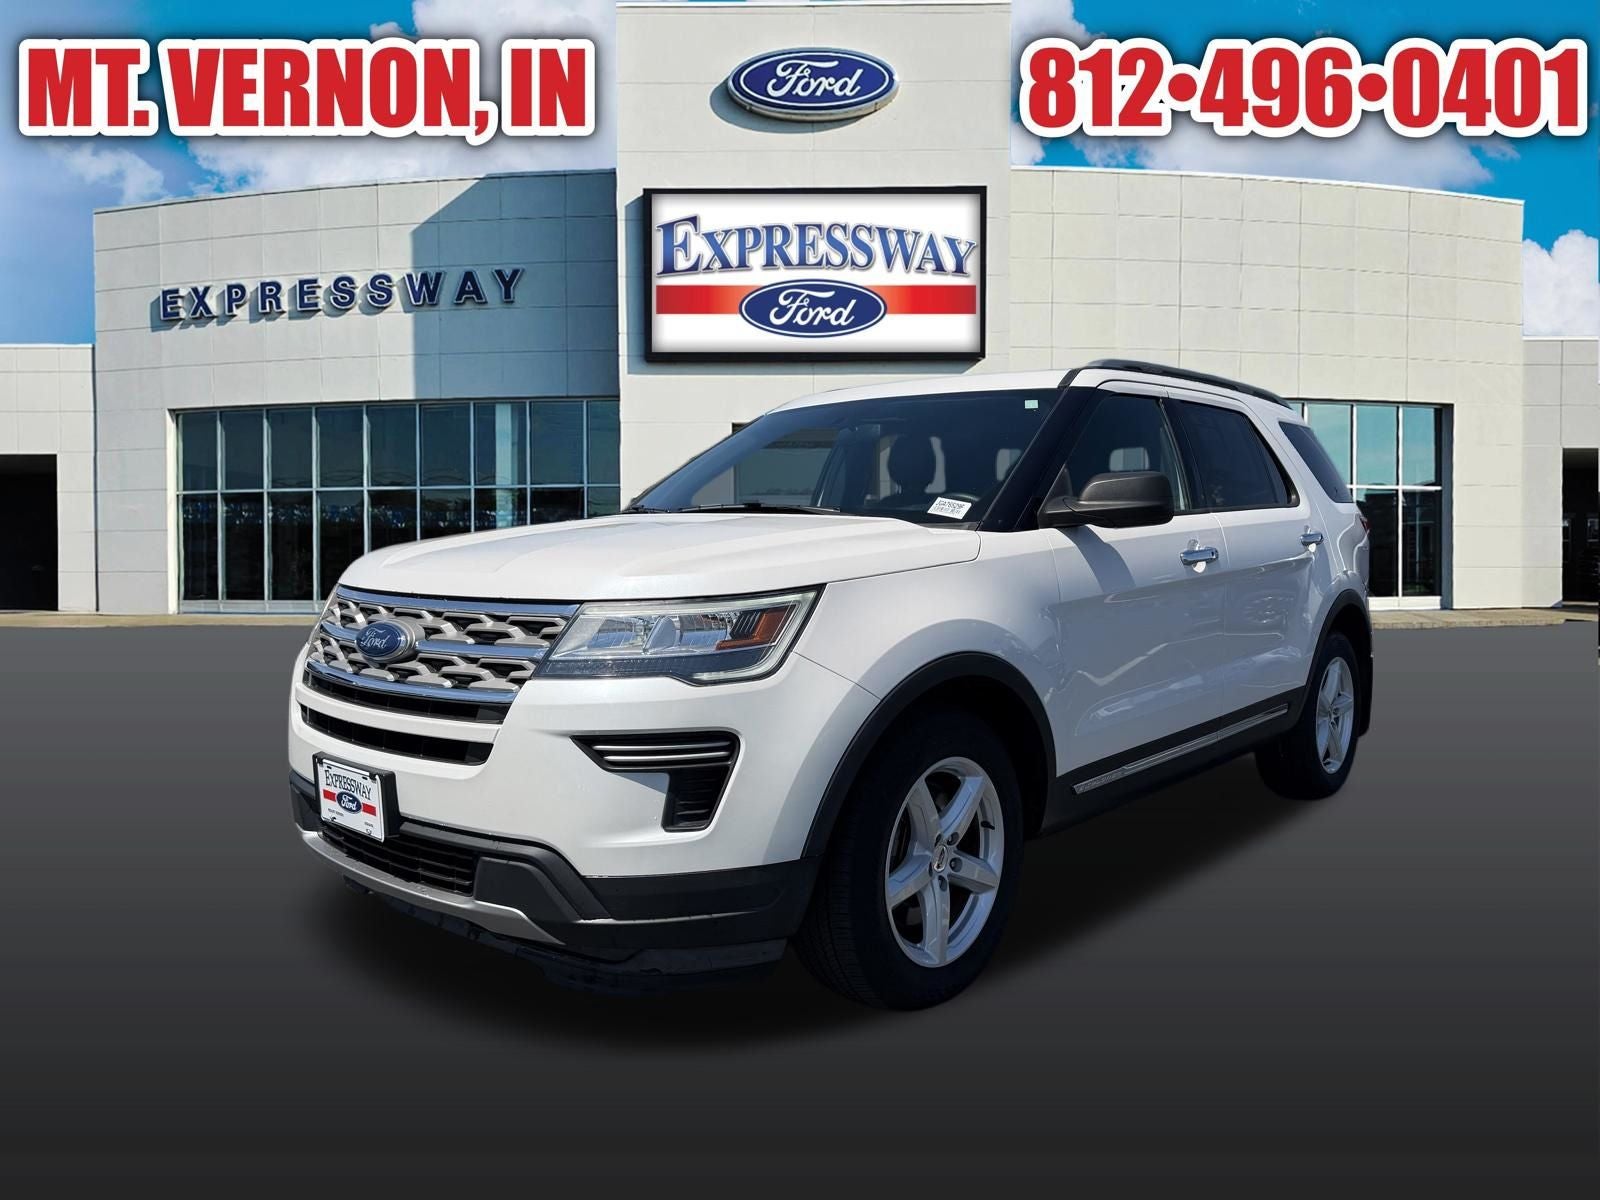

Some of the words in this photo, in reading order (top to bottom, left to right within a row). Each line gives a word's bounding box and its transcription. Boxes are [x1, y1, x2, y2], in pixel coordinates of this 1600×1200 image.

[766, 59, 864, 97] Ford
[656, 214, 977, 278] EXPRESSWAY
[159, 268, 525, 321] EXPRESSWAY
[769, 288, 857, 326] Ford
[360, 627, 391, 649] Ford
[324, 769, 372, 800] EXPRESSWAY
[340, 794, 358, 810] Ford
